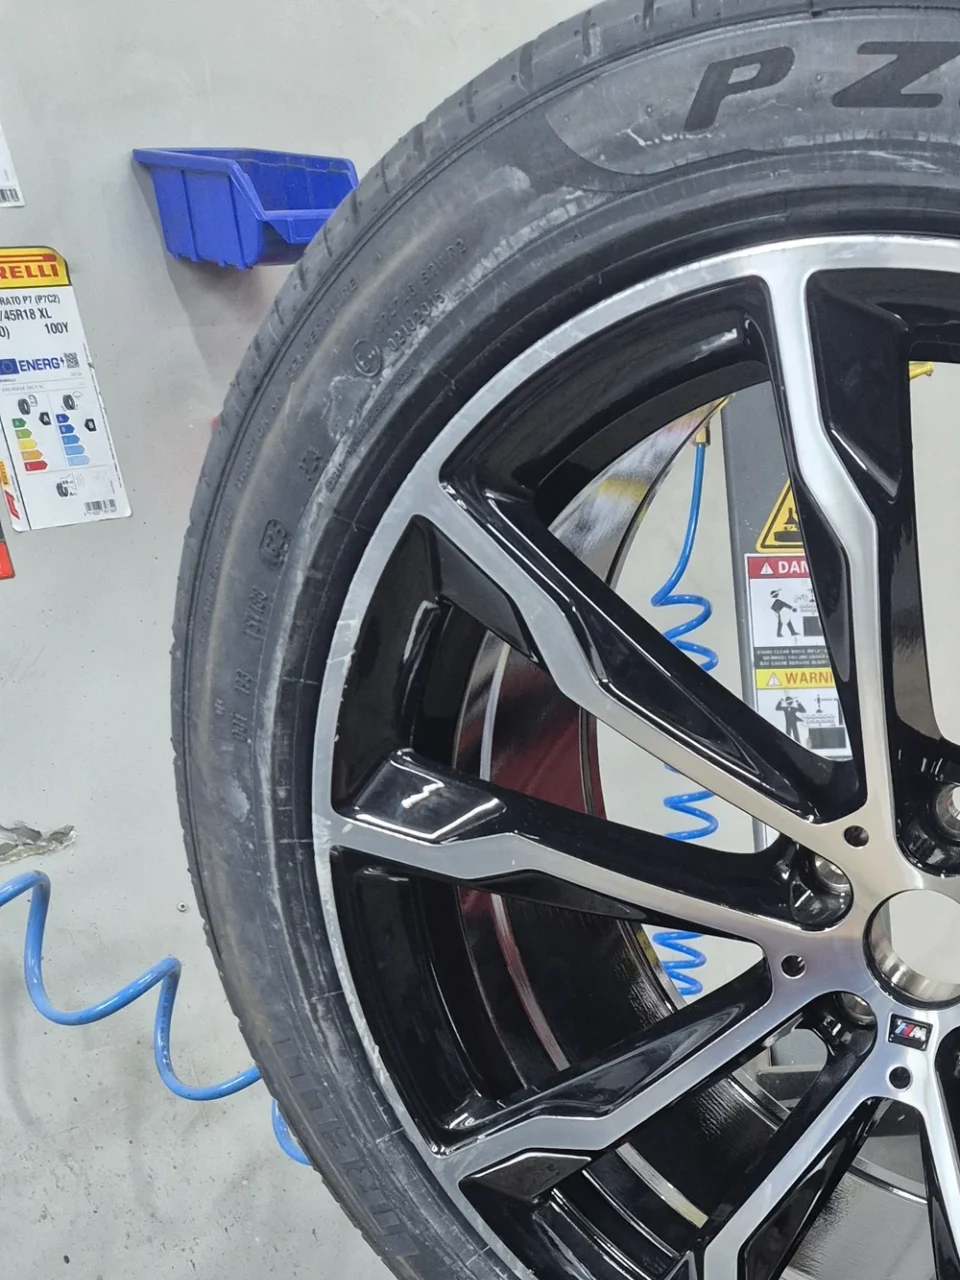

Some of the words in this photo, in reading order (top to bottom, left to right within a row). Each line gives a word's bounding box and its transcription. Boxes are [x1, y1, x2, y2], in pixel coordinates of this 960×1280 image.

[684, 45, 797, 132] P
[0, 264, 59, 279] RELLI
[0, 296, 20, 305] RATO
[0, 308, 36, 321] /45R18
[38, 307, 52, 319] XL
[45, 321, 68, 334] 100Y
[778, 561, 809, 574] DAN
[785, 672, 833, 684] WARNI
